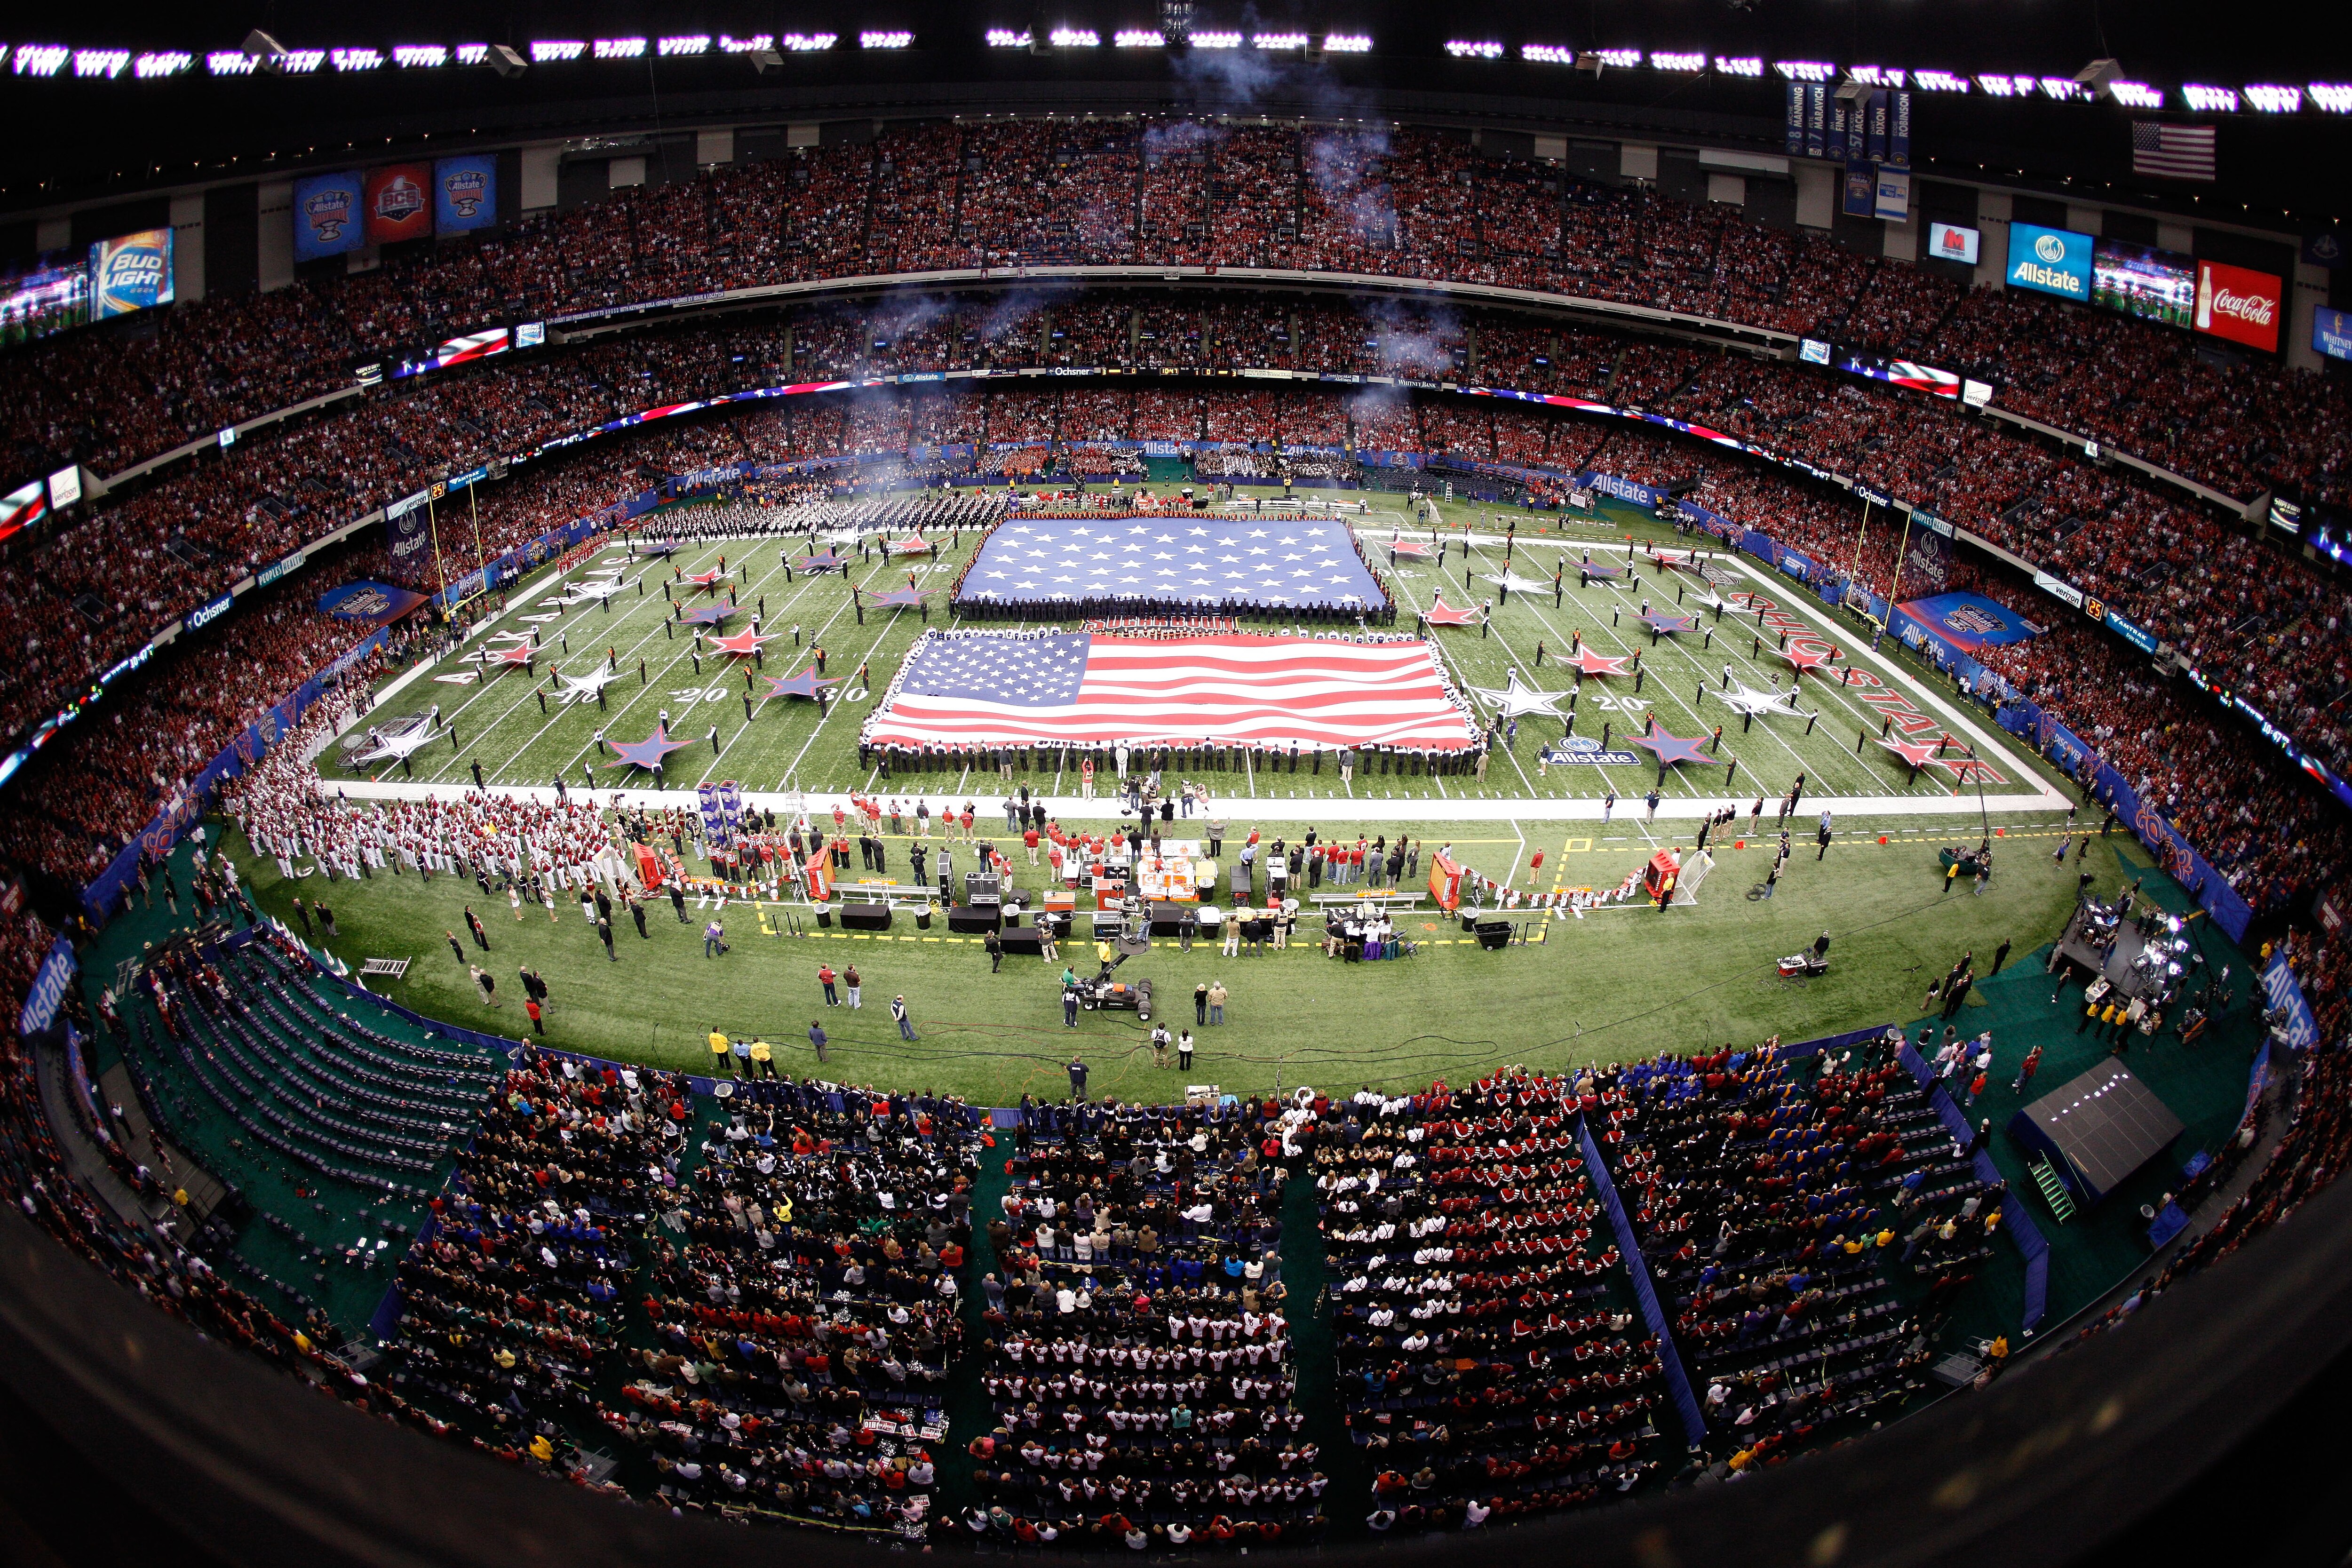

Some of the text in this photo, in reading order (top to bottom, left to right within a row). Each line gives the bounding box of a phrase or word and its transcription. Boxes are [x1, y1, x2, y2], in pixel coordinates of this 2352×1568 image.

[1794, 87, 1804, 127] MANNING
[1814, 88, 1824, 129] MARAVICH
[1899, 94, 1909, 137] ROBINSON
[1875, 108, 1885, 136] DIXON
[1849, 134, 1863, 148] 57
[452, 181, 480, 190] Allstate
[312, 200, 344, 213] Allstate
[383, 192, 417, 207] BCS
[1942, 248, 1965, 256] PRESS
[112, 254, 162, 271] BUD
[104, 271, 163, 288] LIGHT
[2014, 262, 2080, 291] Allstate
[2214, 288, 2275, 326] Coca-Cola
[2328, 344, 2345, 358] BANK
[1055, 367, 1090, 375] Ochsner
[458, 470, 480, 483] AMTRAK
[54, 487, 76, 502] verizon
[432, 486, 443, 497] 25
[1589, 474, 1648, 503] Allstate
[1859, 486, 1888, 507] Ochsner
[406, 495, 427, 509] verizon
[1912, 510, 1952, 535] PEOPLES HEALTH
[393, 531, 426, 557] Allstate
[282, 554, 303, 572] HEALTH
[1910, 549, 1944, 579] Allstate
[259, 565, 282, 586] PEOPLES
[458, 572, 482, 592] Allstate
[343, 593, 369, 611] Allstate
[2056, 586, 2079, 605] verizon
[193, 597, 230, 627] Ochsner
[2089, 600, 2102, 617] 25
[1966, 610, 1994, 628] Allstate
[2118, 620, 2148, 641] AMTRAK
[334, 650, 360, 675] Allstate
[674, 688, 728, 702] 20
[1592, 696, 1644, 711] 20
[2262, 721, 2280, 742] 10:47
[1551, 753, 1630, 763] Allstate
[23, 950, 70, 1034] llstate
[2264, 961, 2311, 1049] Allstat
